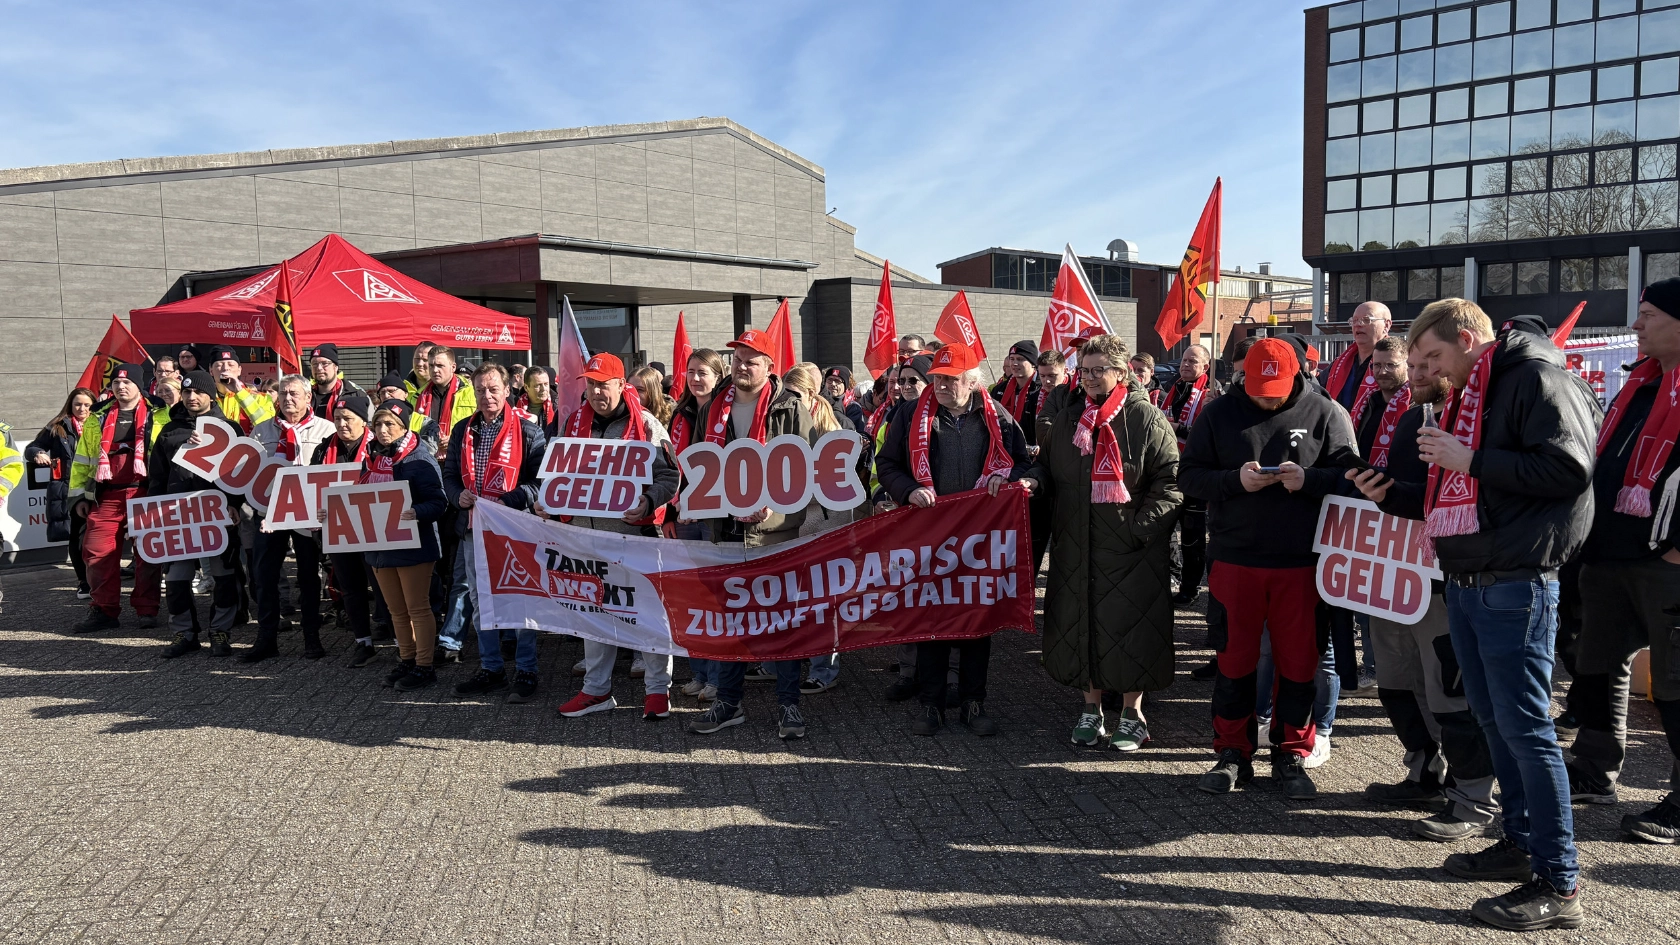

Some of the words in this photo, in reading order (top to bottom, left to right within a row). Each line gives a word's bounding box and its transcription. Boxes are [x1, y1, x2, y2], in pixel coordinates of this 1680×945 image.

[430, 324, 471, 334] GEMEINSAM
[471, 326, 483, 334] FÜR
[455, 334, 475, 342] GUTES
[476, 334, 494, 342] LEBEN
[543, 442, 650, 478] MEHR
[686, 438, 858, 511] 200€
[544, 476, 636, 512] GELD
[29, 514, 48, 526] NU
[132, 495, 225, 531] MEHR
[328, 488, 413, 546] ATZ
[142, 524, 223, 559] GELD
[724, 530, 1017, 609] SOLIDARISCH
[1322, 552, 1422, 616] GELD
[580, 605, 587, 613] &
[838, 572, 1017, 622] GESTALTEN
[685, 602, 830, 637] ZUKUNFT
